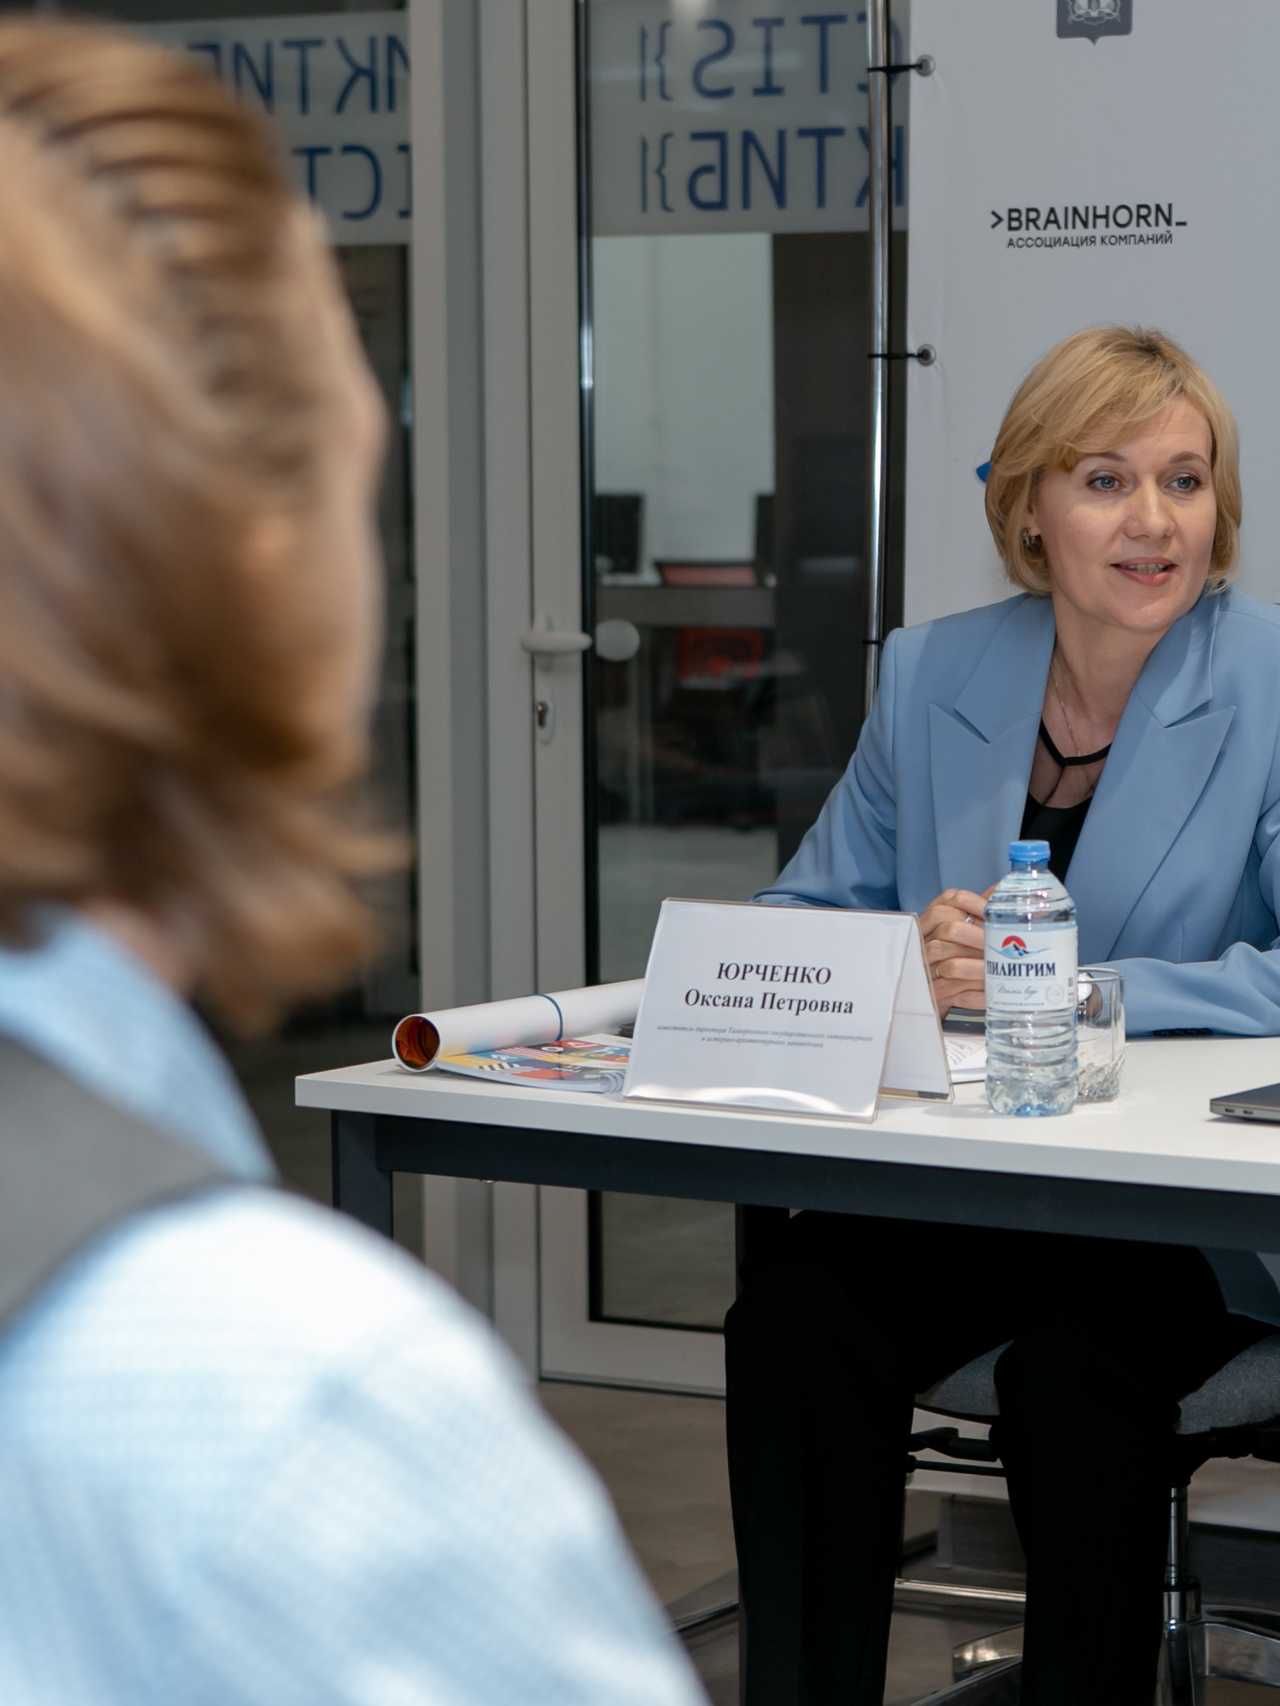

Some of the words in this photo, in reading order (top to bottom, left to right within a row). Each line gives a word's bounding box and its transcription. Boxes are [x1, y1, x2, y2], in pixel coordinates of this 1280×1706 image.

[1007, 235, 1096, 249] АССОЦИАЦИЯ
[1100, 230, 1173, 247] КОМПАНИЙ
[716, 962, 832, 985] ЮРЧЕНКО
[987, 961, 1056, 977] ПИЛИГРИМ
[684, 988, 754, 1009] Оксана
[760, 992, 853, 1016] Петровна
